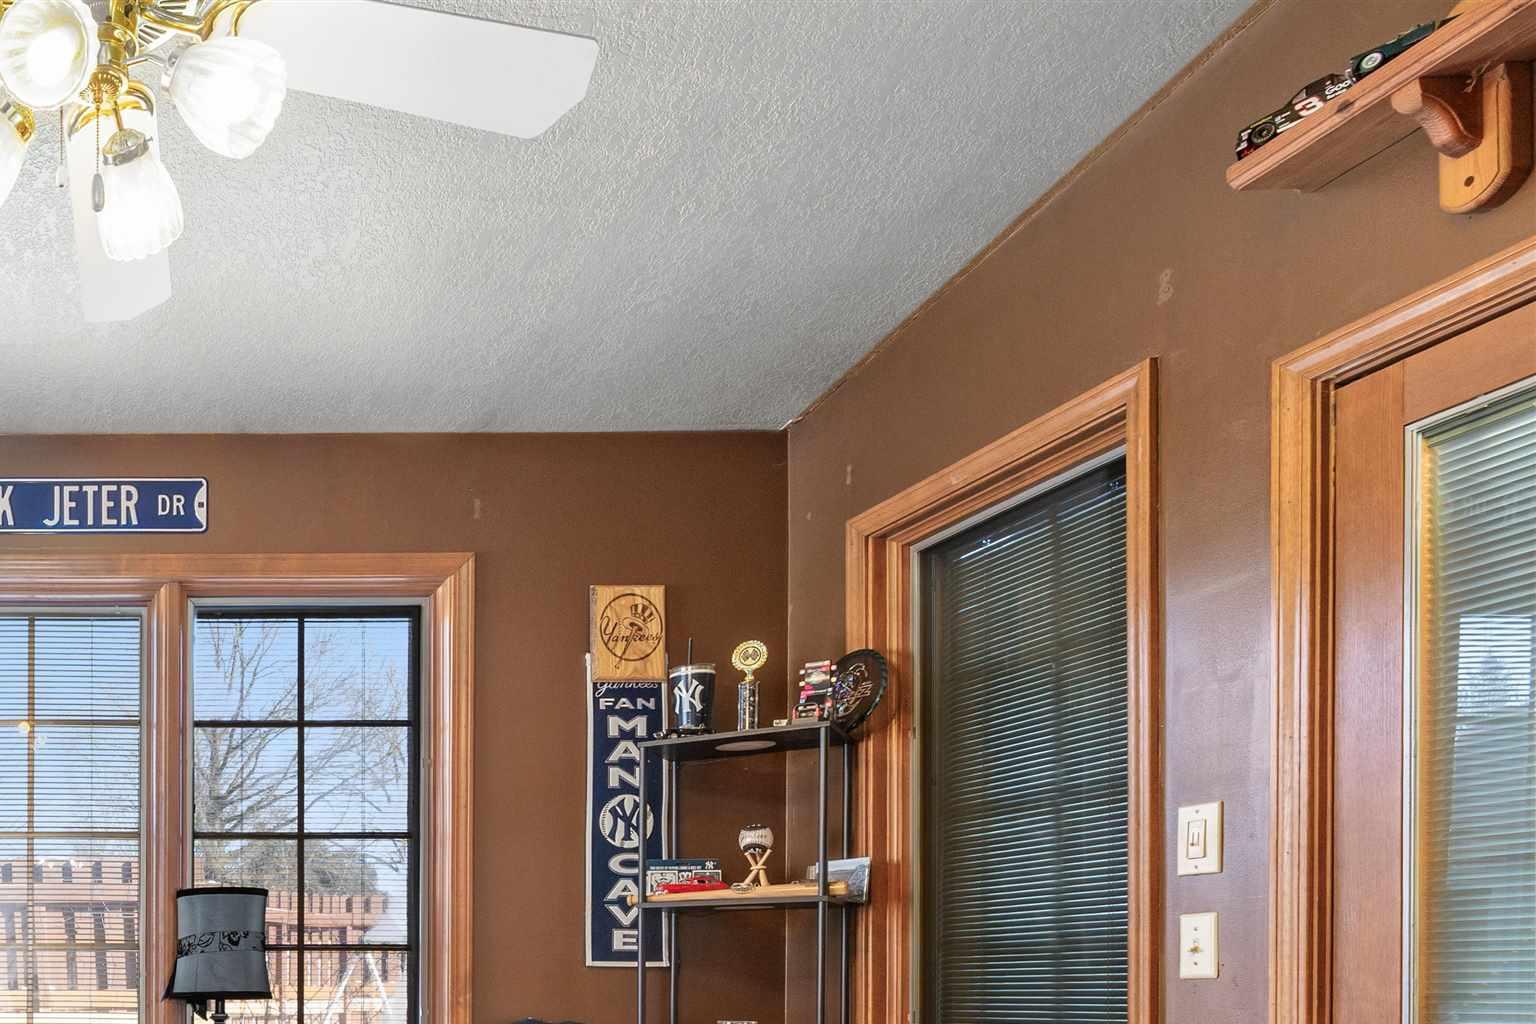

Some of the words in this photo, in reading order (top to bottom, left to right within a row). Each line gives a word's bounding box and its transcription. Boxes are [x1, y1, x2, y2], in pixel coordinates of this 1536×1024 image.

[1294, 96, 1324, 117] 3
[43, 485, 139, 525] JETER
[158, 494, 185, 516] DR
[599, 698, 656, 710] FAN
[605, 714, 648, 789] MAN
